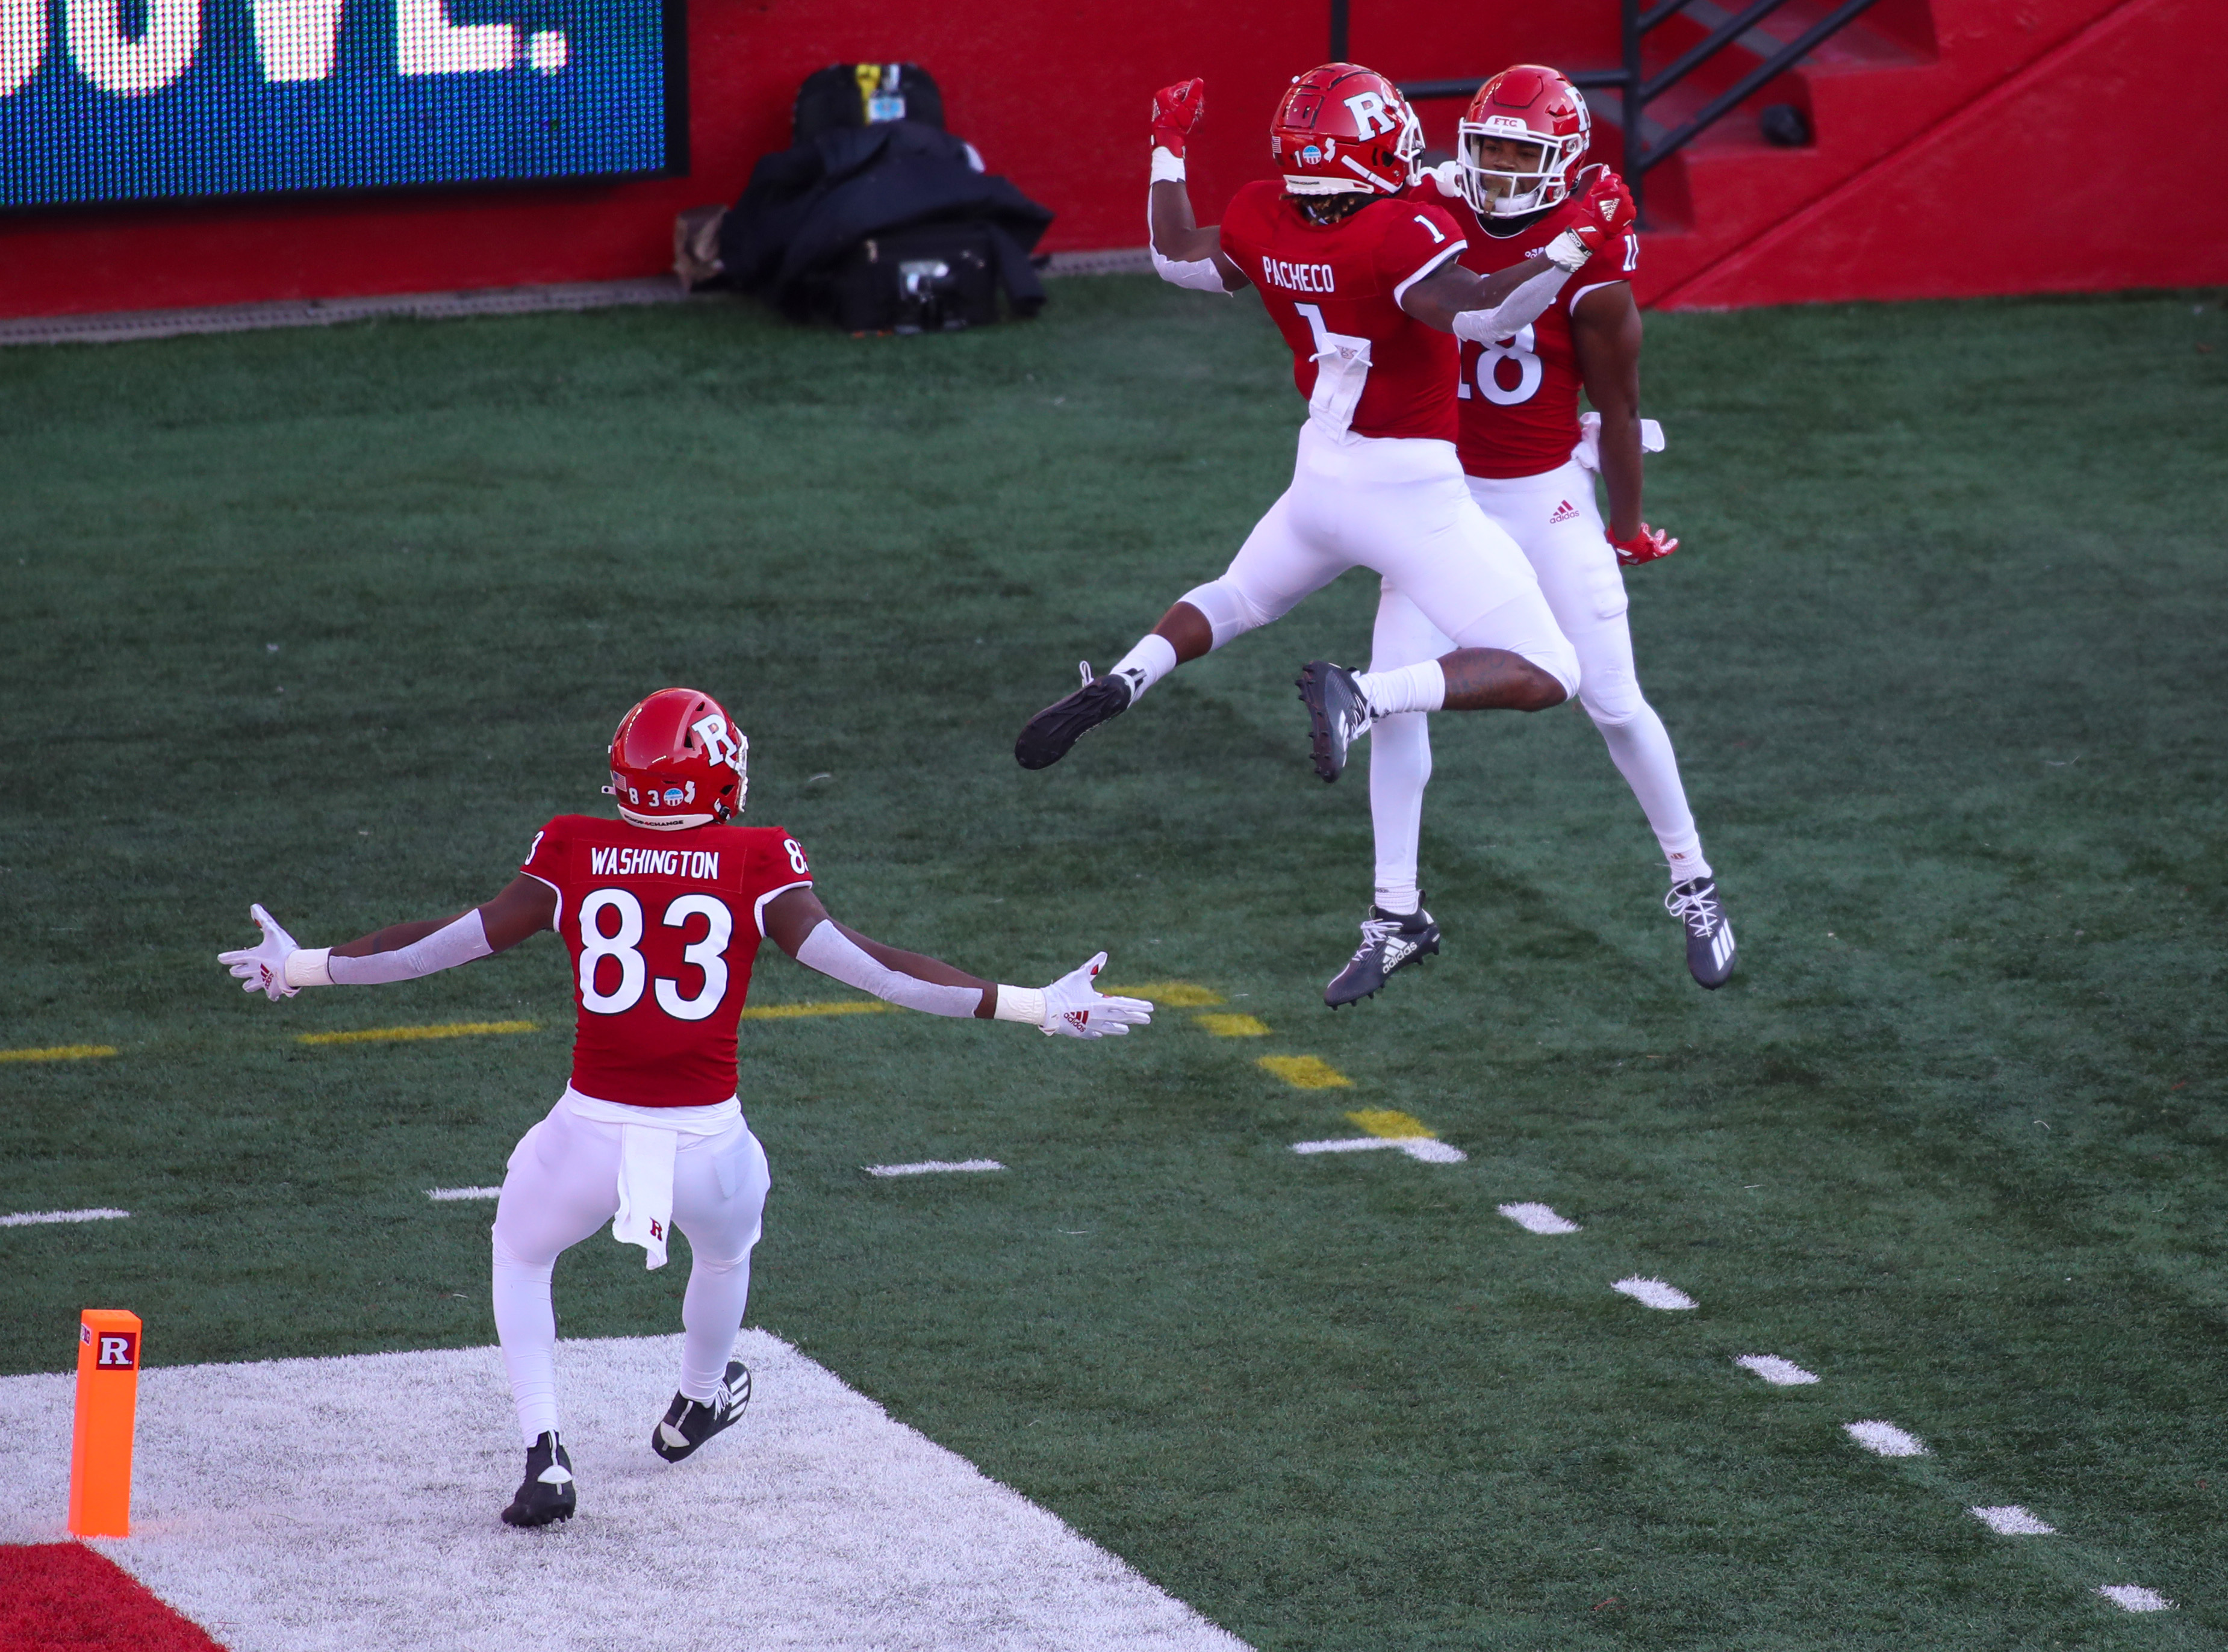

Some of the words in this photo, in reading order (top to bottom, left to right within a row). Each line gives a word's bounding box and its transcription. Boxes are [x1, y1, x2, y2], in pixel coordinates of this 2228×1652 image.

[1343, 92, 1395, 142] R
[1493, 117, 1517, 127] FTC
[1295, 151, 1302, 168] 1
[1413, 214, 1445, 243] 1
[1262, 256, 1334, 293] PACHECO
[1457, 323, 1543, 406] 8
[1549, 510, 1579, 524] adidas
[691, 714, 738, 766] R
[591, 847, 719, 880] WASHINGTON
[783, 838, 809, 875] 8
[579, 889, 732, 1020] 83
[1383, 942, 1417, 974] adidas
[1063, 1012, 1086, 1032] adidas
[649, 1216, 662, 1241] R
[99, 1337, 132, 1365] R
